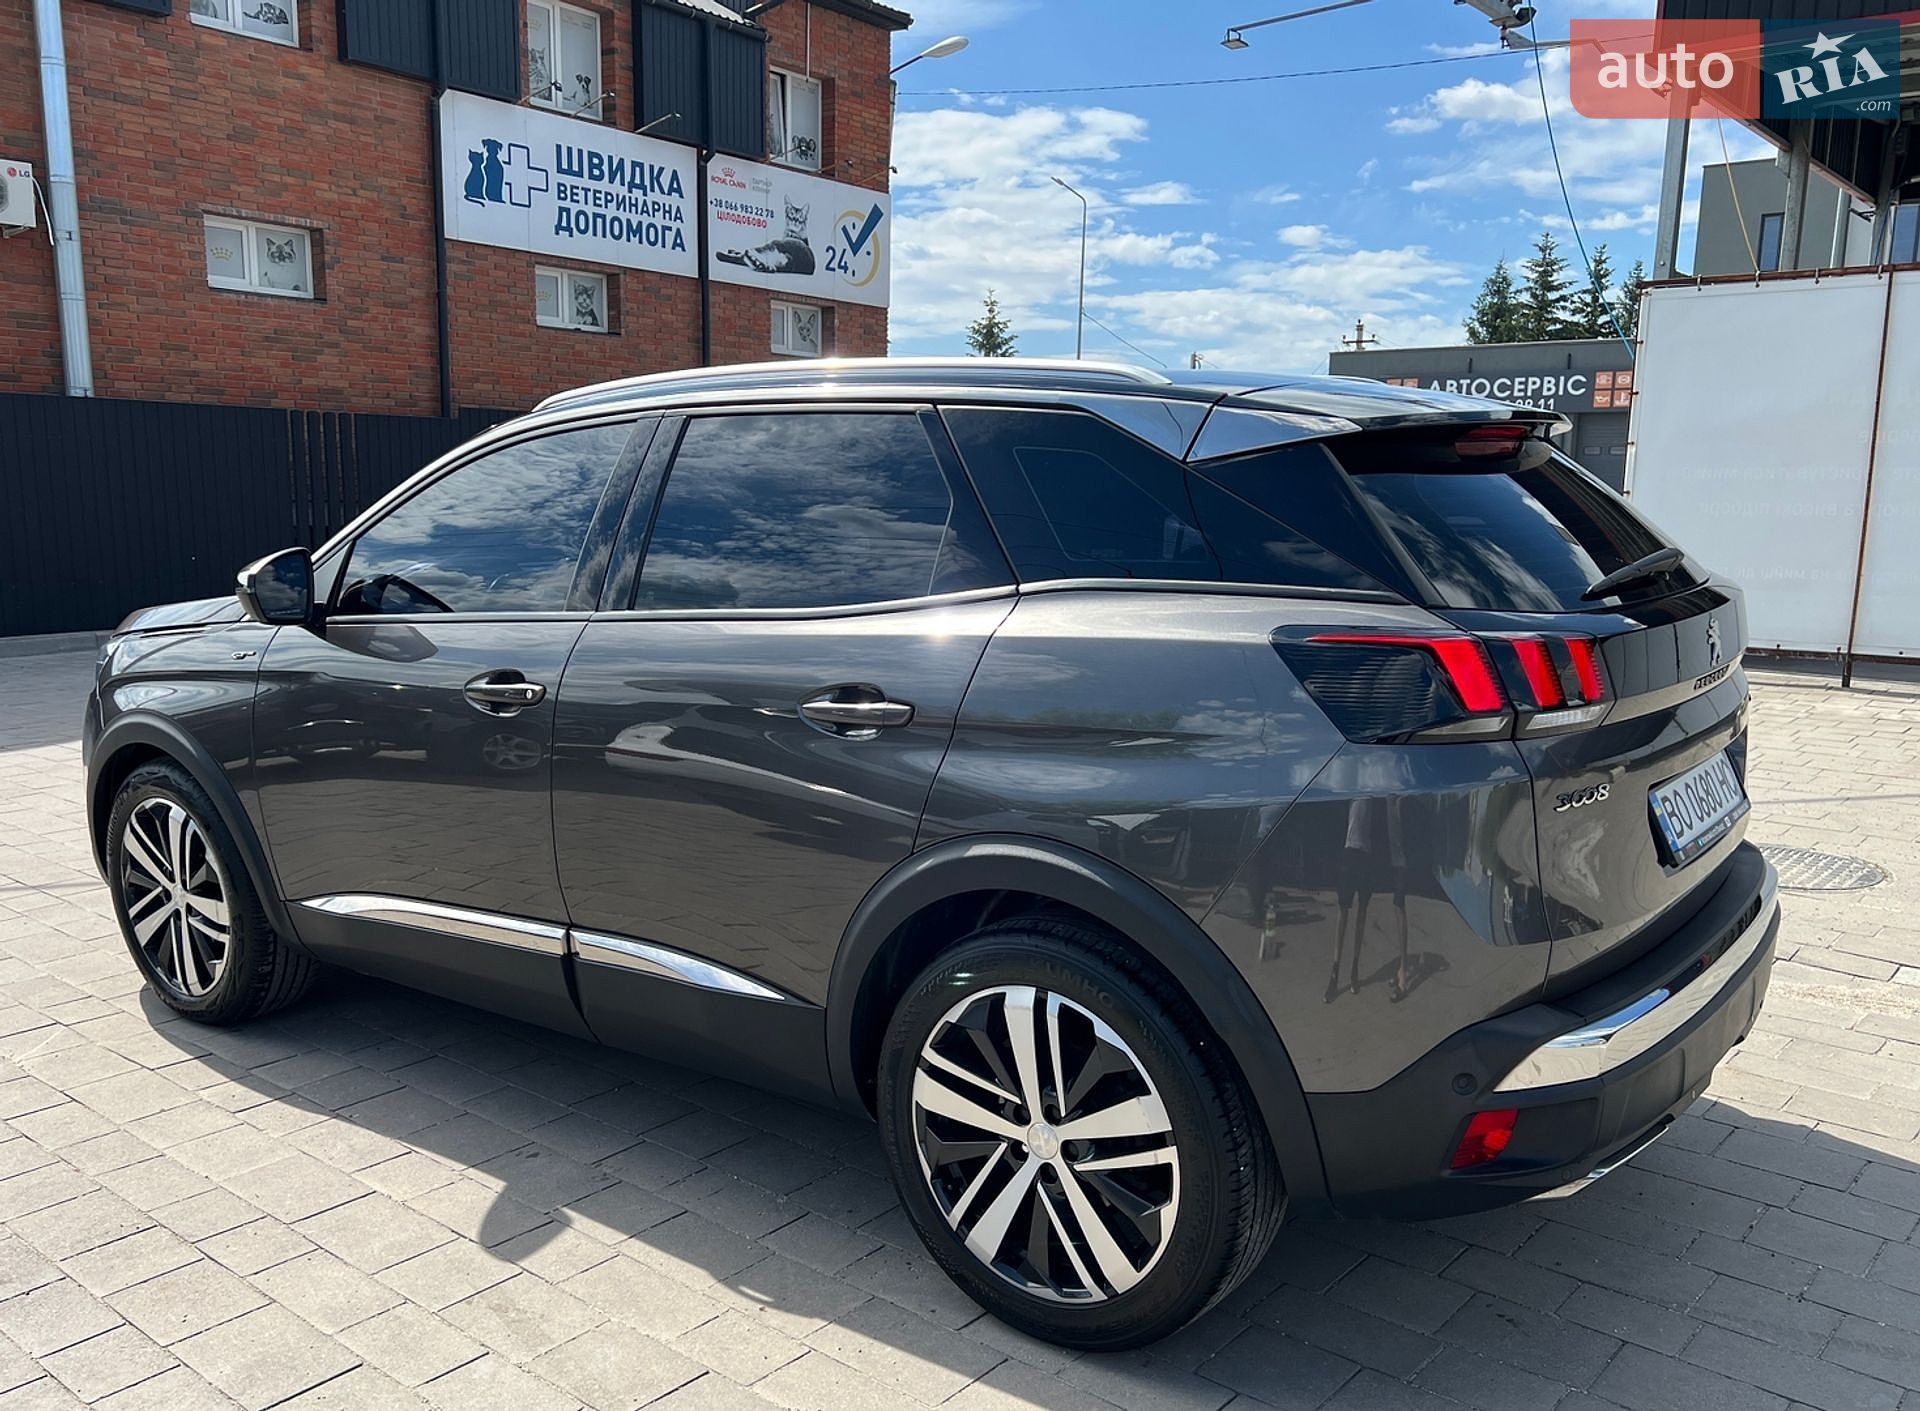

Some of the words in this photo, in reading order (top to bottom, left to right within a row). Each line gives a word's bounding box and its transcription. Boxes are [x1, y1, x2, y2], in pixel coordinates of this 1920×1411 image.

[19, 169, 30, 178] LG
[555, 143, 685, 199] ШВИДКА
[557, 181, 684, 224] ВЕТЕРИНАРНА
[554, 205, 686, 252] ДОПОМОГА
[1553, 783, 1610, 813] 3008
